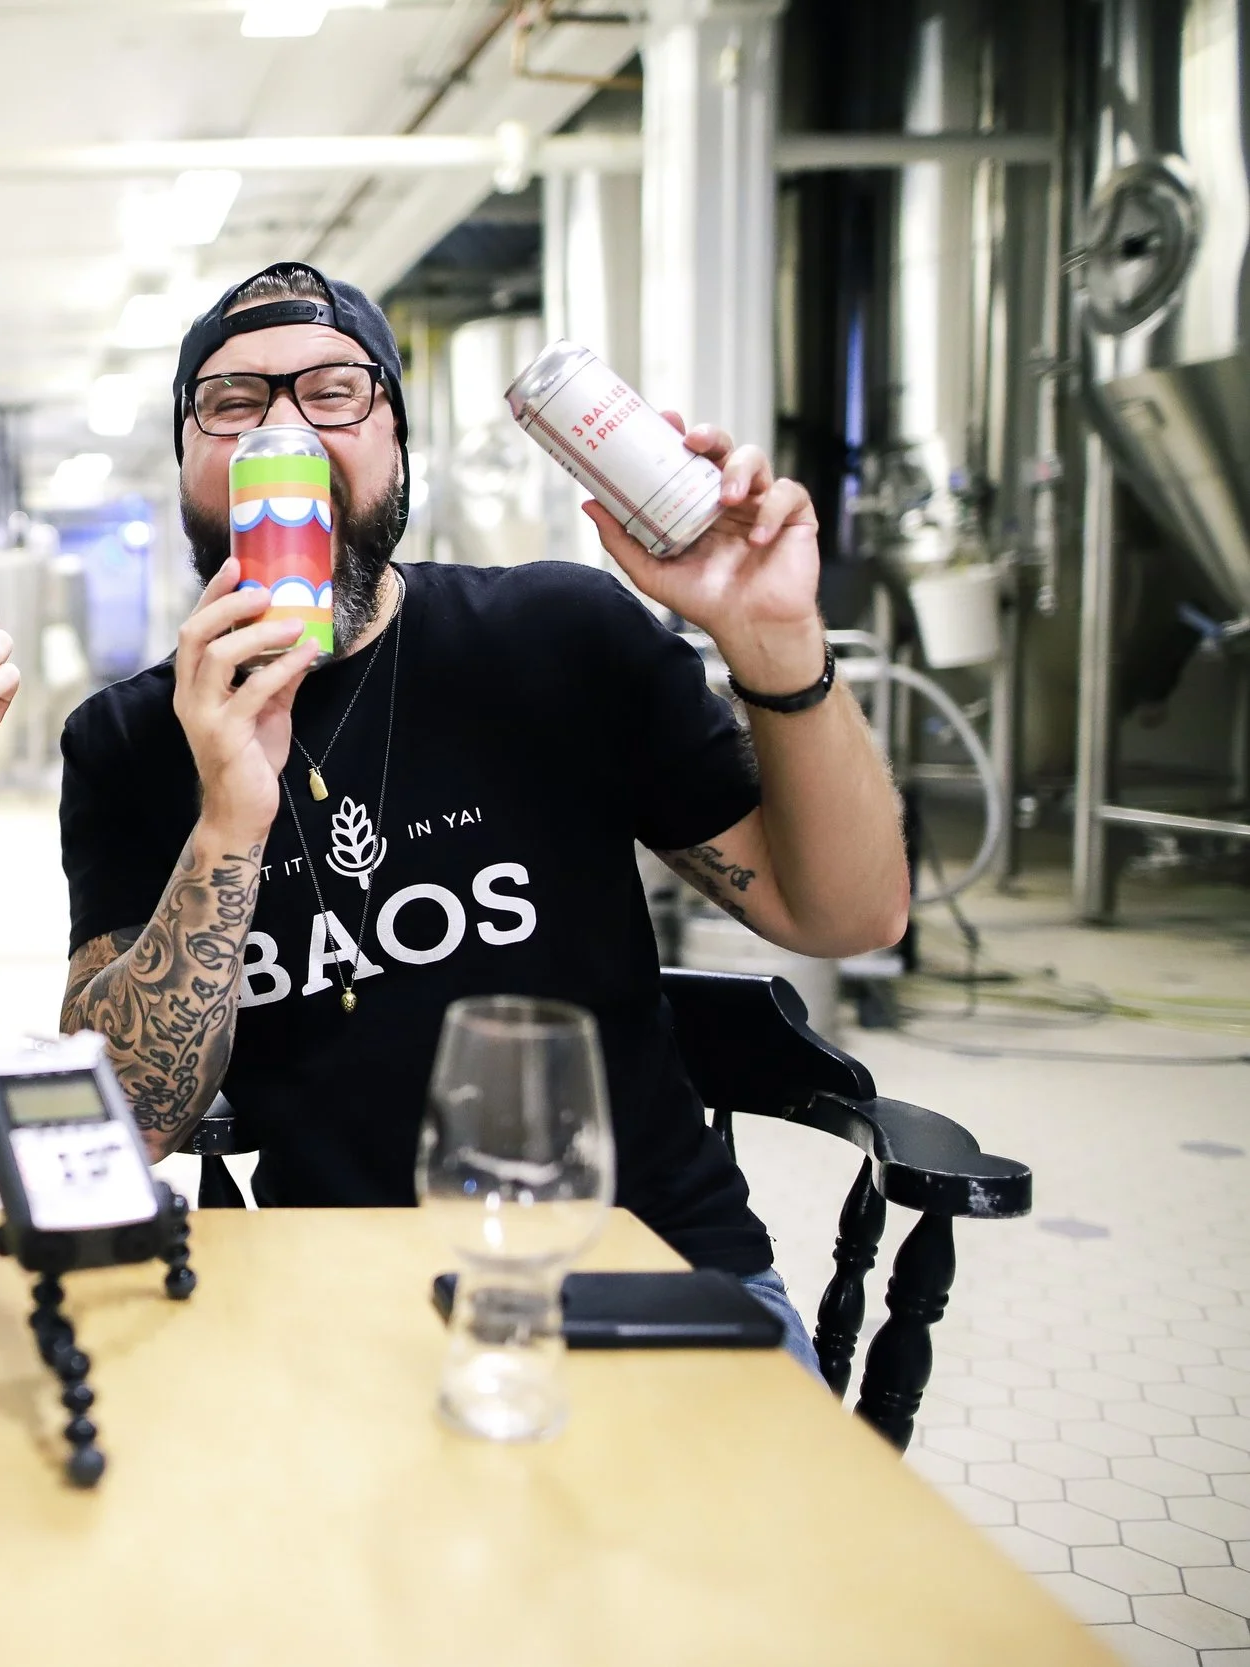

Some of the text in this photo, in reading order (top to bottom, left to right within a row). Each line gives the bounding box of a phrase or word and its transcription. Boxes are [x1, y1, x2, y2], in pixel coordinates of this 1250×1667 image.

[572, 385, 627, 437] 3 BALLES
[586, 398, 641, 450] 2 PRISES
[284, 857, 303, 876] IT
[407, 819, 432, 840] IN
[442, 807, 483, 829] YA!
[238, 862, 537, 1009] BAOS
[151, 994, 201, 1051] but
[191, 976, 217, 1004] a
